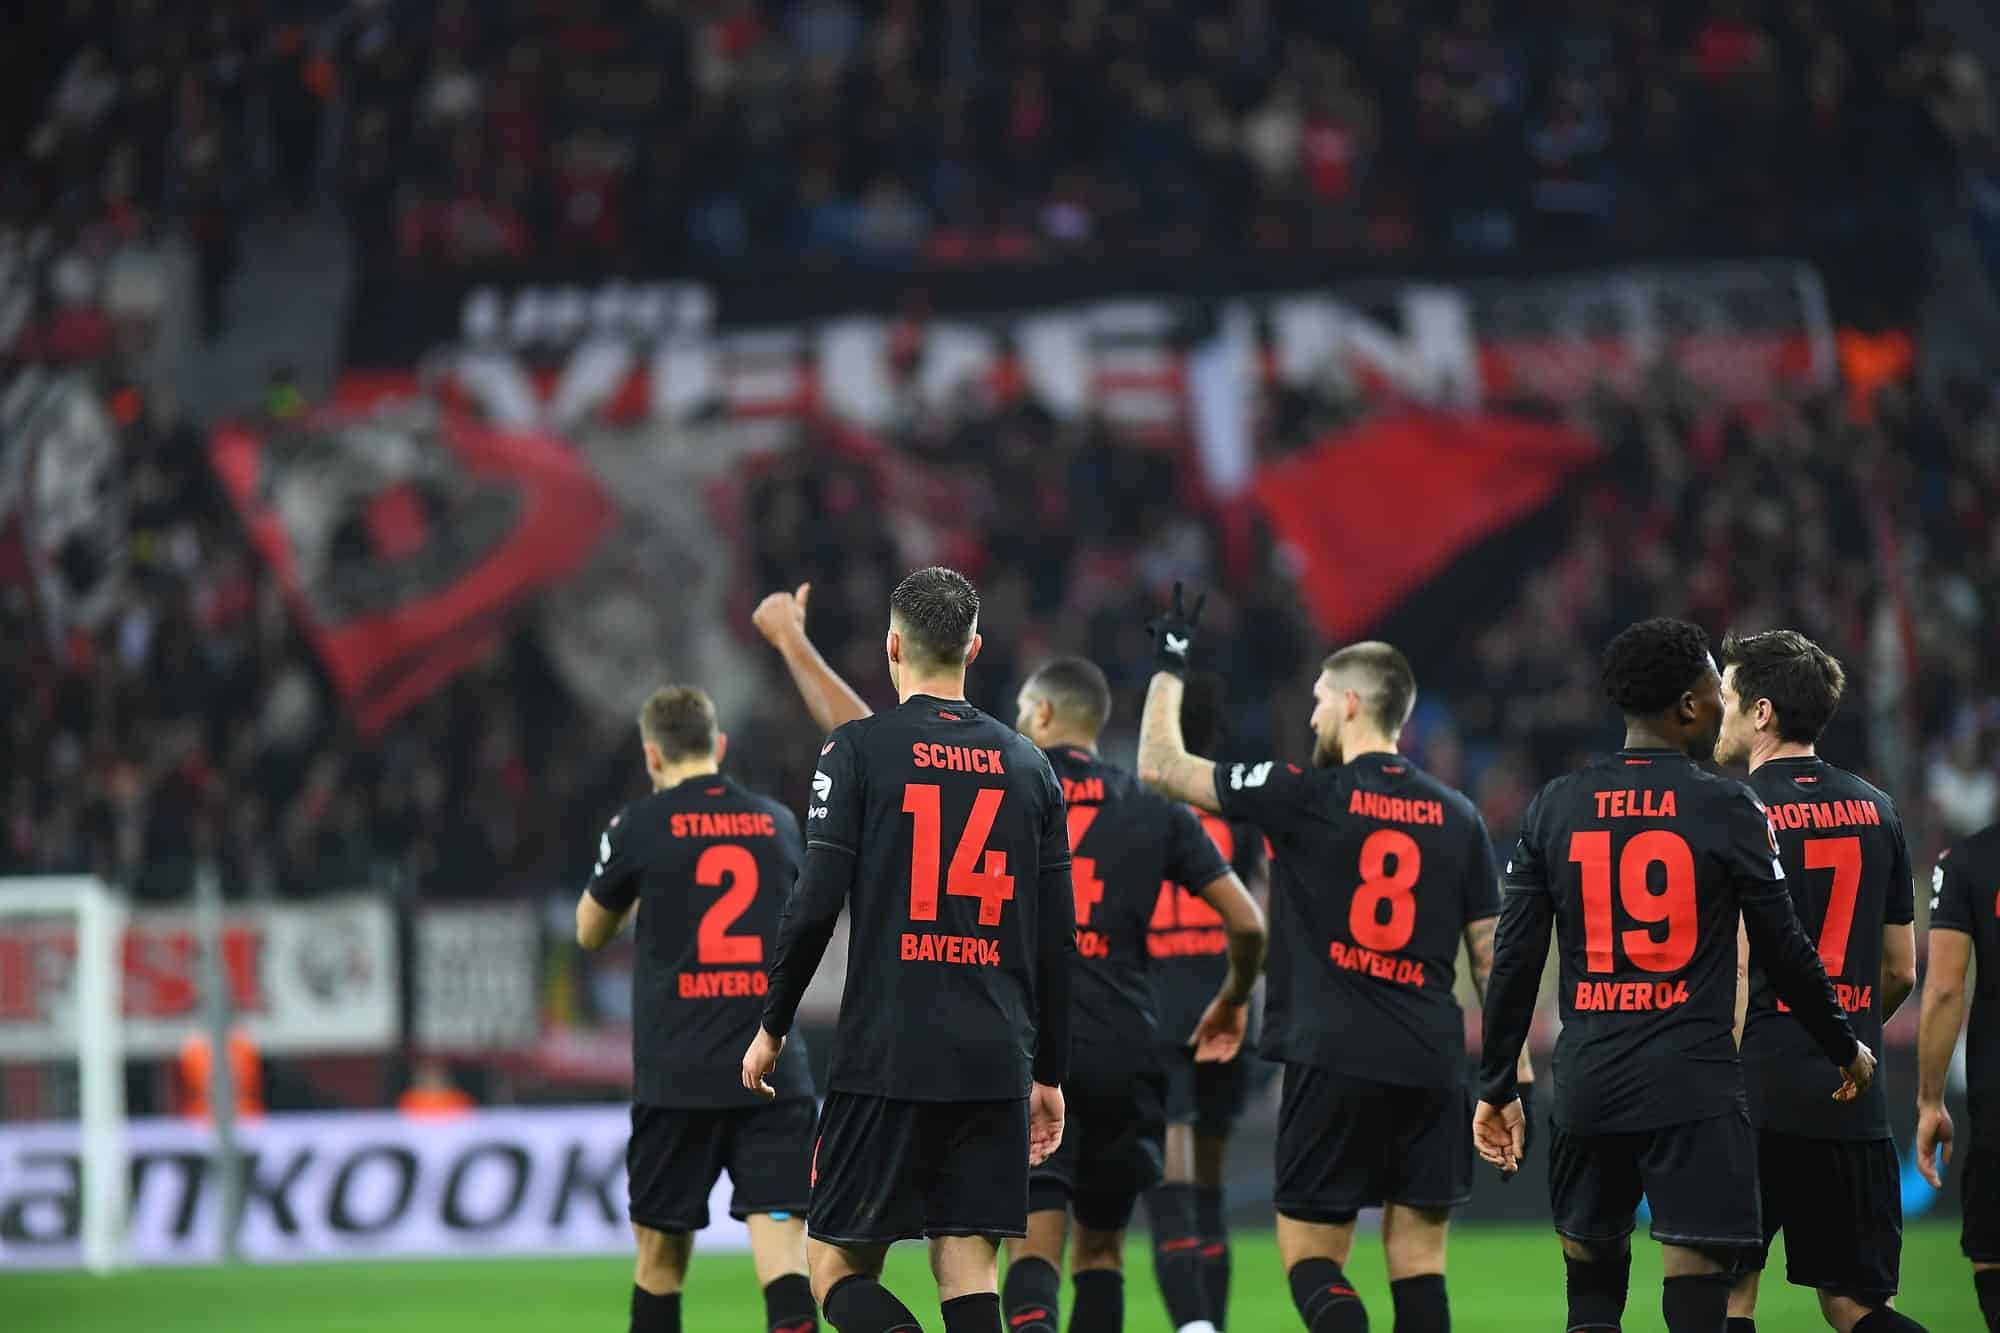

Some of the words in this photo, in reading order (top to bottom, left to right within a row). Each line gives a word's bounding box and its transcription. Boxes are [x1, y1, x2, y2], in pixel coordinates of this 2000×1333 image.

[912, 742, 1005, 774] SCHICK
[1062, 778, 1104, 802] TAH
[1349, 789, 1443, 825] ANDRICH
[1590, 789, 1677, 818] TELLA
[671, 813, 775, 837] STANISIC
[1765, 799, 1880, 831] HOFMANN
[902, 783, 1015, 926] 14
[1066, 805, 1104, 925] 4
[695, 844, 763, 963] 2
[1348, 829, 1421, 951] 8
[1568, 830, 1698, 973] 19
[1804, 836, 1862, 977] 7
[901, 933, 1000, 967] BAYER04
